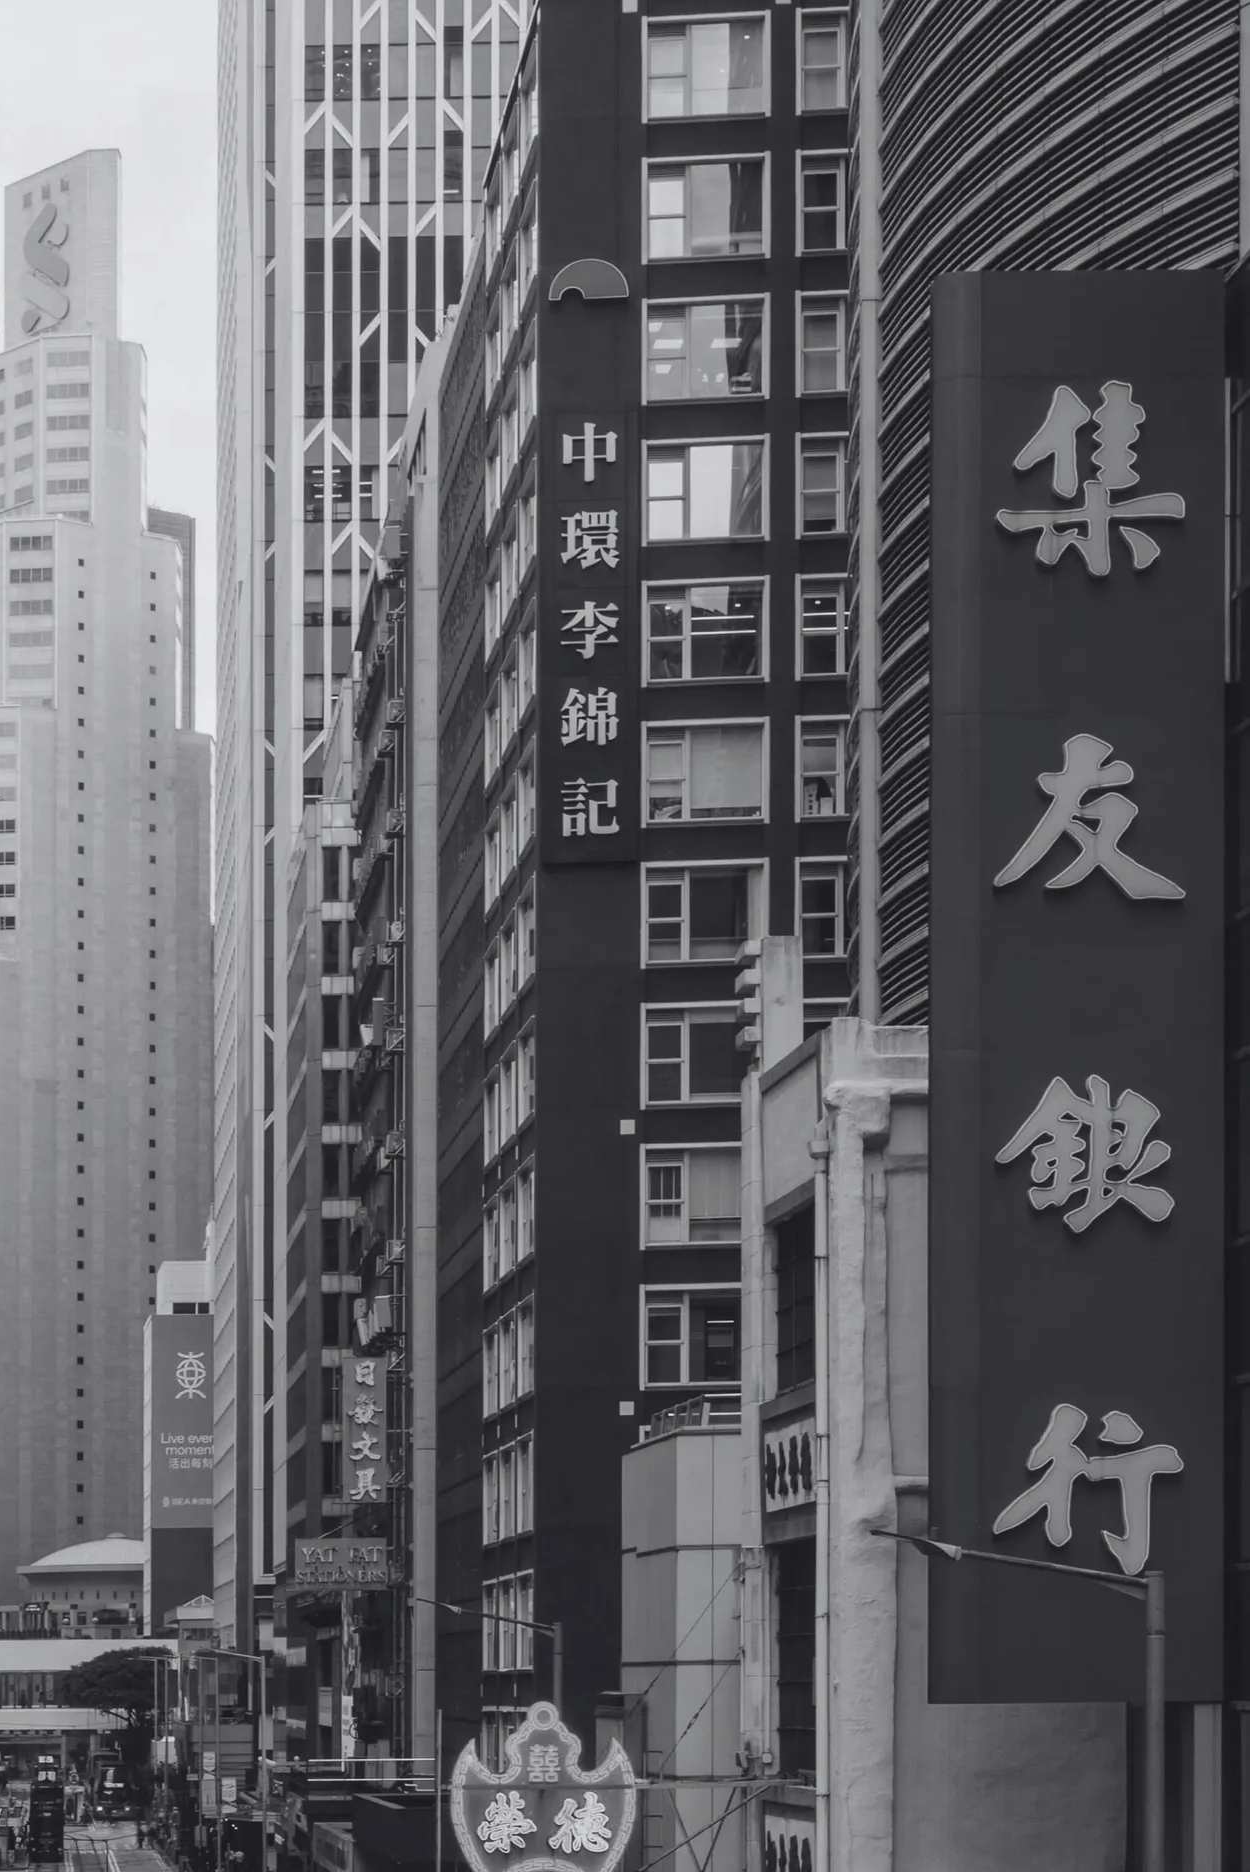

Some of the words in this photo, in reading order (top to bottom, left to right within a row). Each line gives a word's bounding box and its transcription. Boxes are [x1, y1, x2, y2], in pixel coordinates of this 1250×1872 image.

[559, 421, 621, 839] 中環李錦記
[992, 380, 1186, 1576] 集友銀行
[160, 1432, 184, 1444] Live
[346, 1360, 383, 1500] 日發文具
[296, 1570, 386, 1584] STATIONERS
[301, 1546, 338, 1563] YAT
